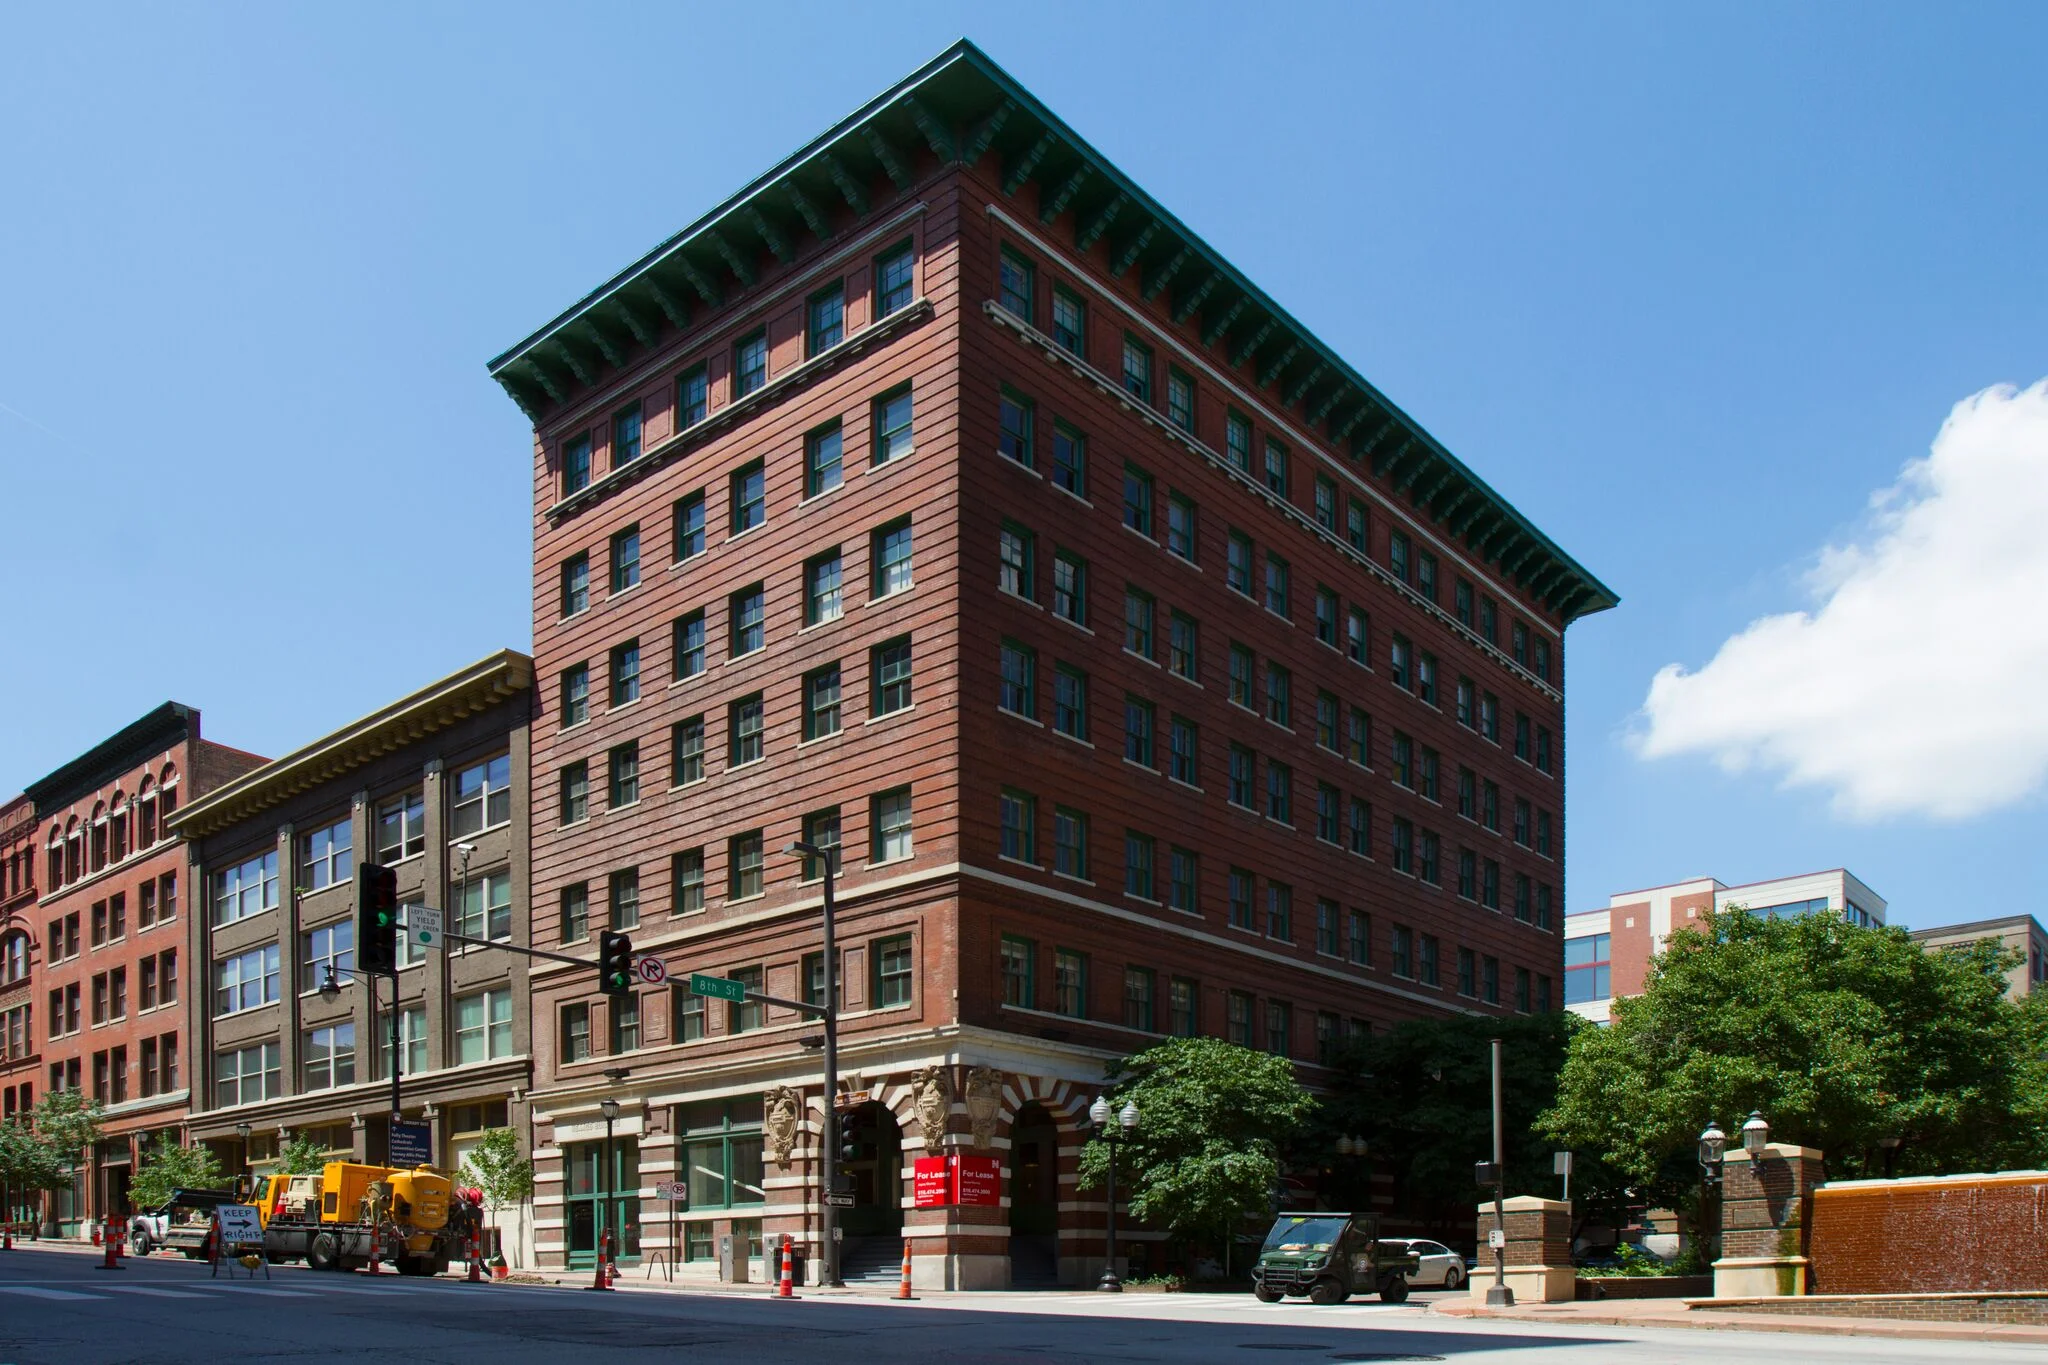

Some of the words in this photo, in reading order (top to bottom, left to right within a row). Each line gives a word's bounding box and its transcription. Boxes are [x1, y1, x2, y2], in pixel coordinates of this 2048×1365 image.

[416, 916, 436, 925] YIELD
[700, 980, 717, 992] 8th
[726, 985, 736, 996] St
[917, 1172, 929, 1180] For
[930, 1171, 951, 1179] Lease
[975, 1171, 994, 1179] Lease
[224, 1209, 252, 1217] KEEP
[225, 1231, 260, 1239] RIGHT
